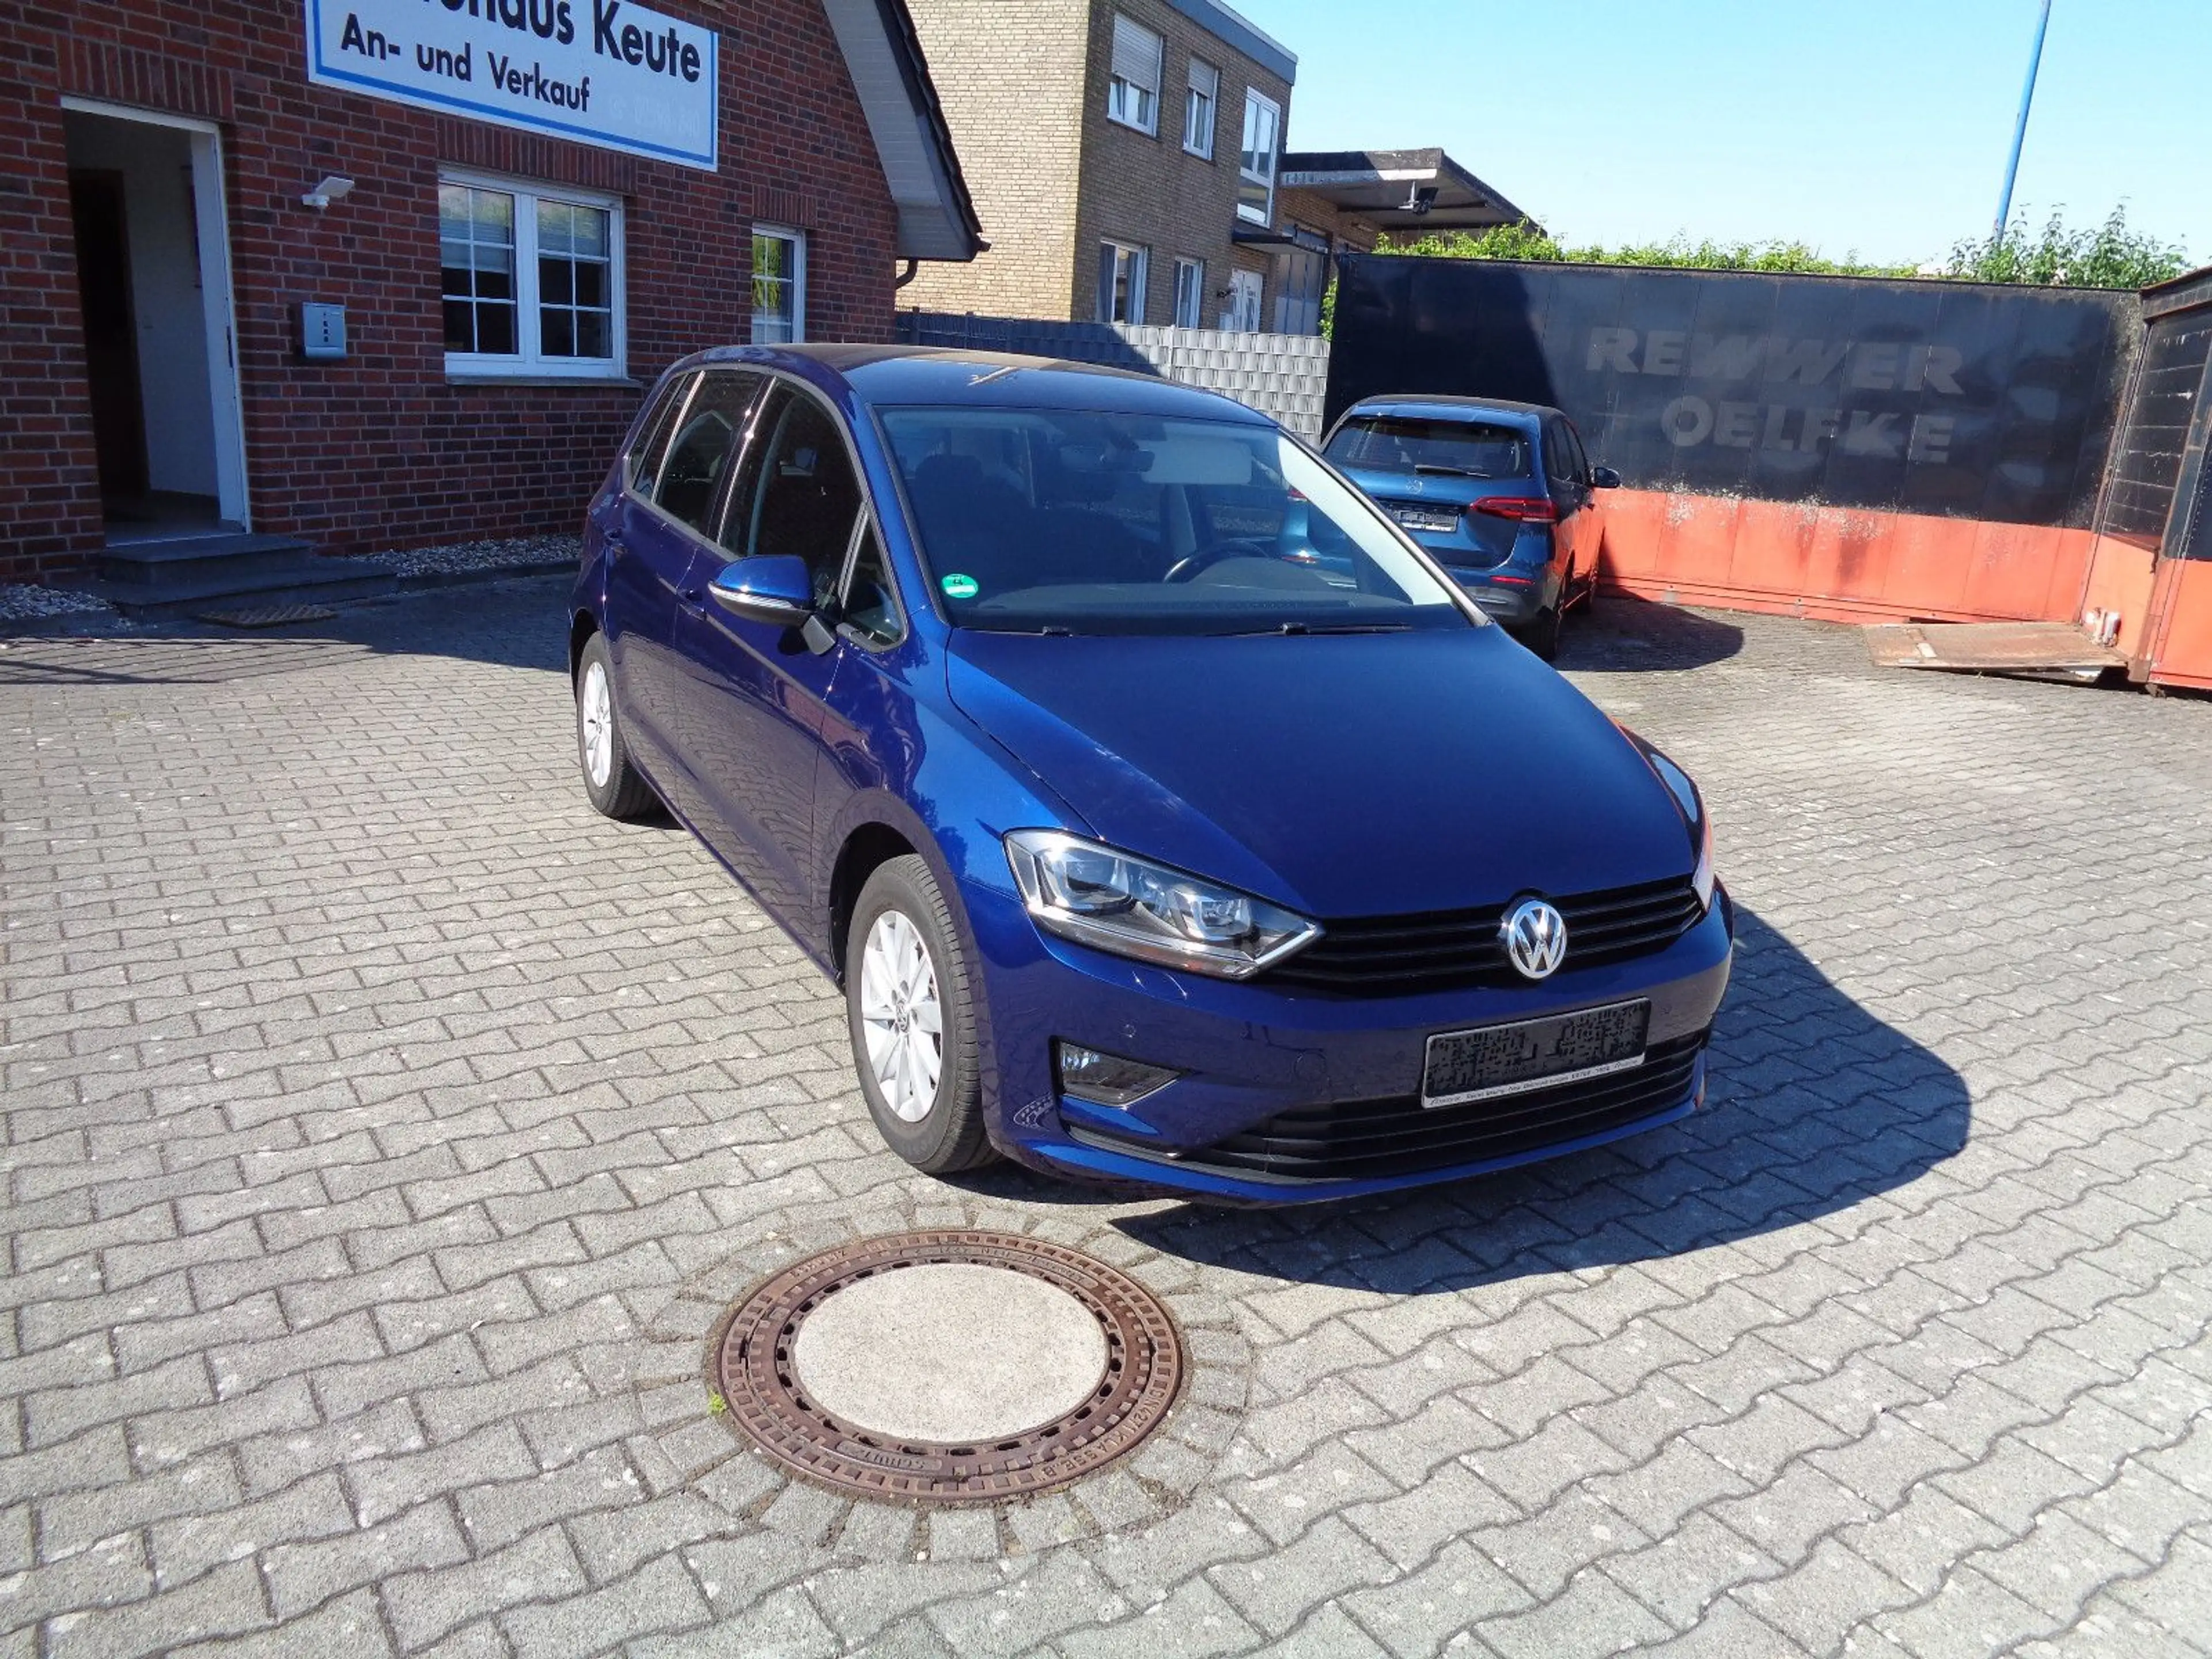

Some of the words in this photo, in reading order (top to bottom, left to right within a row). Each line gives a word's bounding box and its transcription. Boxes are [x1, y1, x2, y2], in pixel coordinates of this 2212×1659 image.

[341, 13, 401, 60] An-
[416, 41, 472, 82] und
[487, 51, 590, 112] Verkauf
[593, 0, 700, 82] Keute
